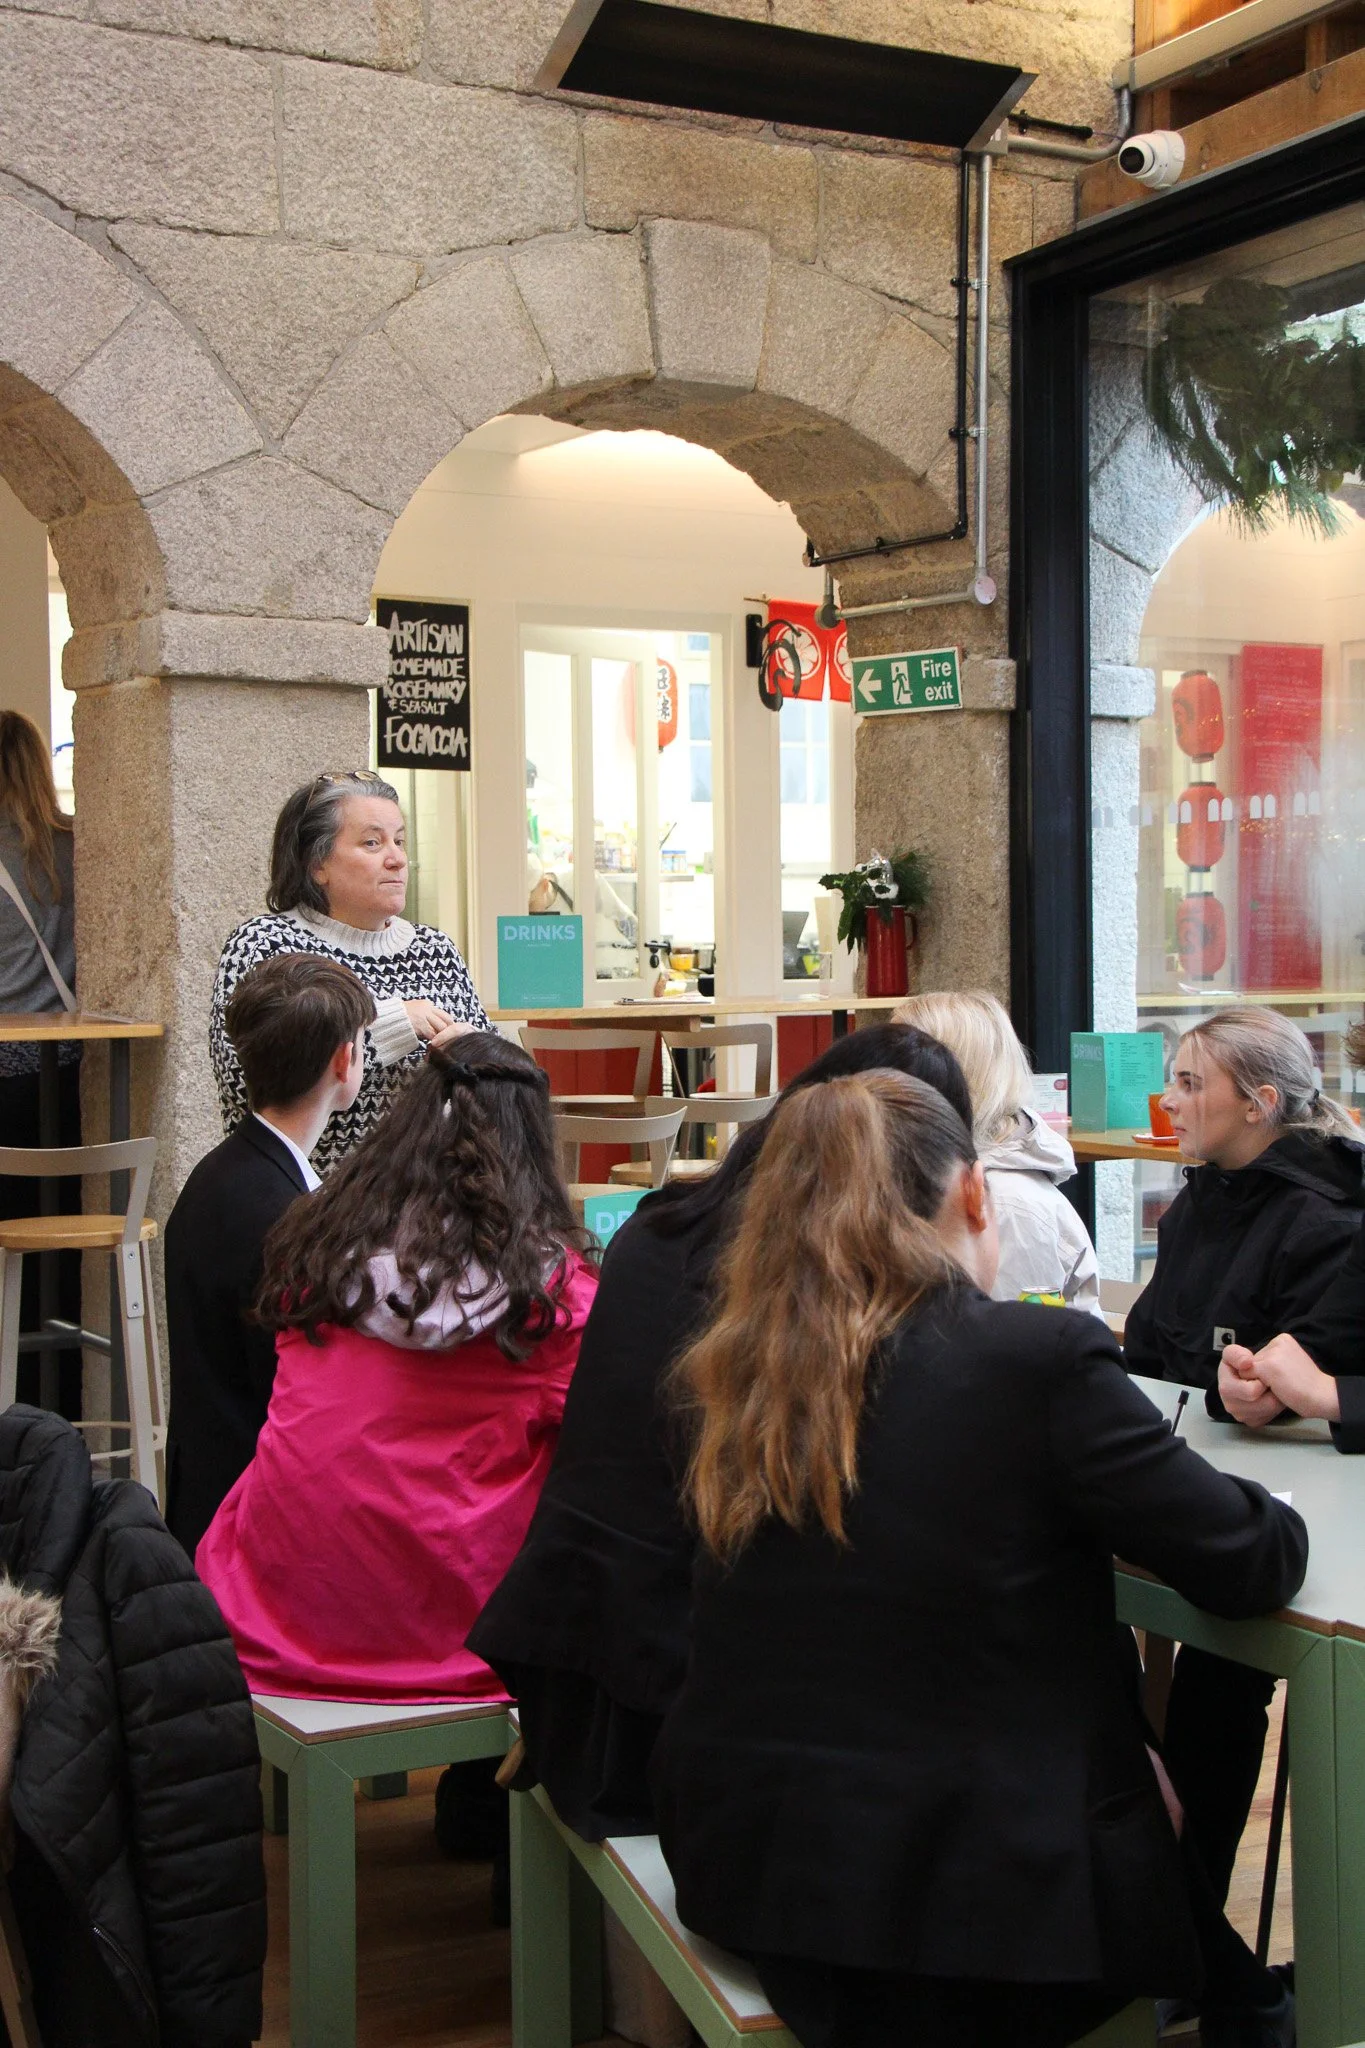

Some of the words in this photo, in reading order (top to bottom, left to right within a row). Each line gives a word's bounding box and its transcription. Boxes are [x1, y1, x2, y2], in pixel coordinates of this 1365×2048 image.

[388, 610, 464, 654] ARTISAN
[920, 659, 952, 679] Fire
[382, 677, 467, 704] ROSEMARY
[924, 681, 954, 701] exit
[383, 715, 469, 758] FOCACCIA
[503, 924, 577, 941] DRINKS
